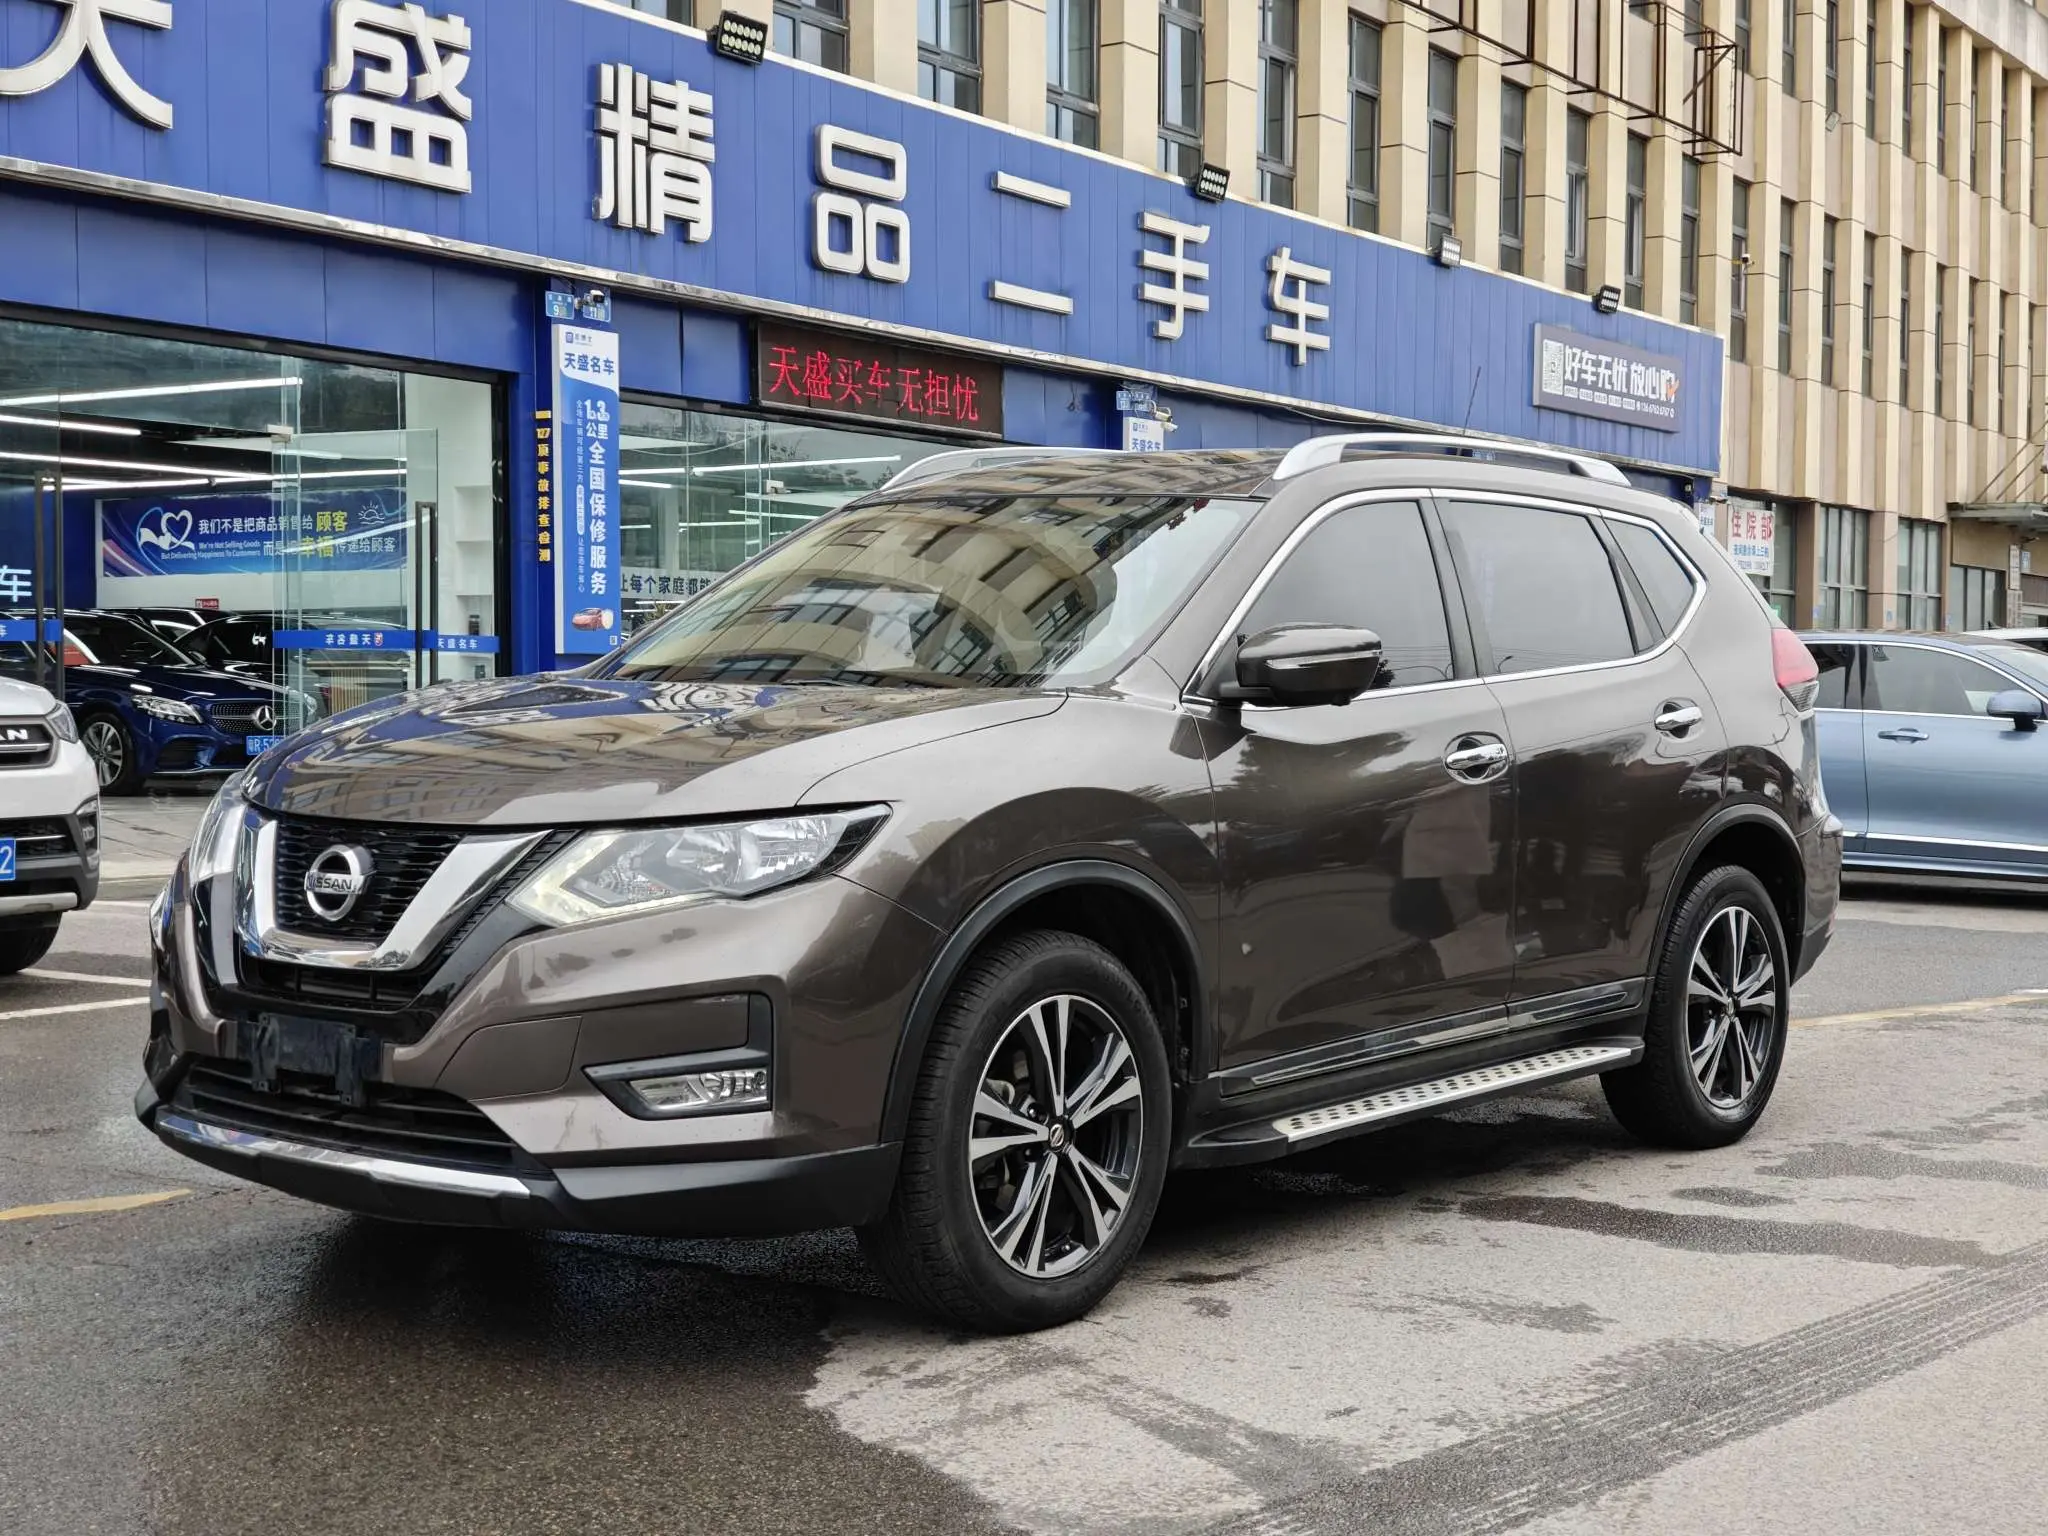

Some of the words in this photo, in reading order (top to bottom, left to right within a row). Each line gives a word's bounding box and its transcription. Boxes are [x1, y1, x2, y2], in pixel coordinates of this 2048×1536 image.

[564, 352, 615, 376] 天盛名车
[1564, 345, 1628, 394] 好车无忧
[769, 346, 979, 421] 天盛买车无担忧
[589, 440, 607, 595] 全国保修服务
[1732, 511, 1773, 541] 住院部
[0, 564, 32, 602] 车
[307, 874, 353, 890] NISSAN
